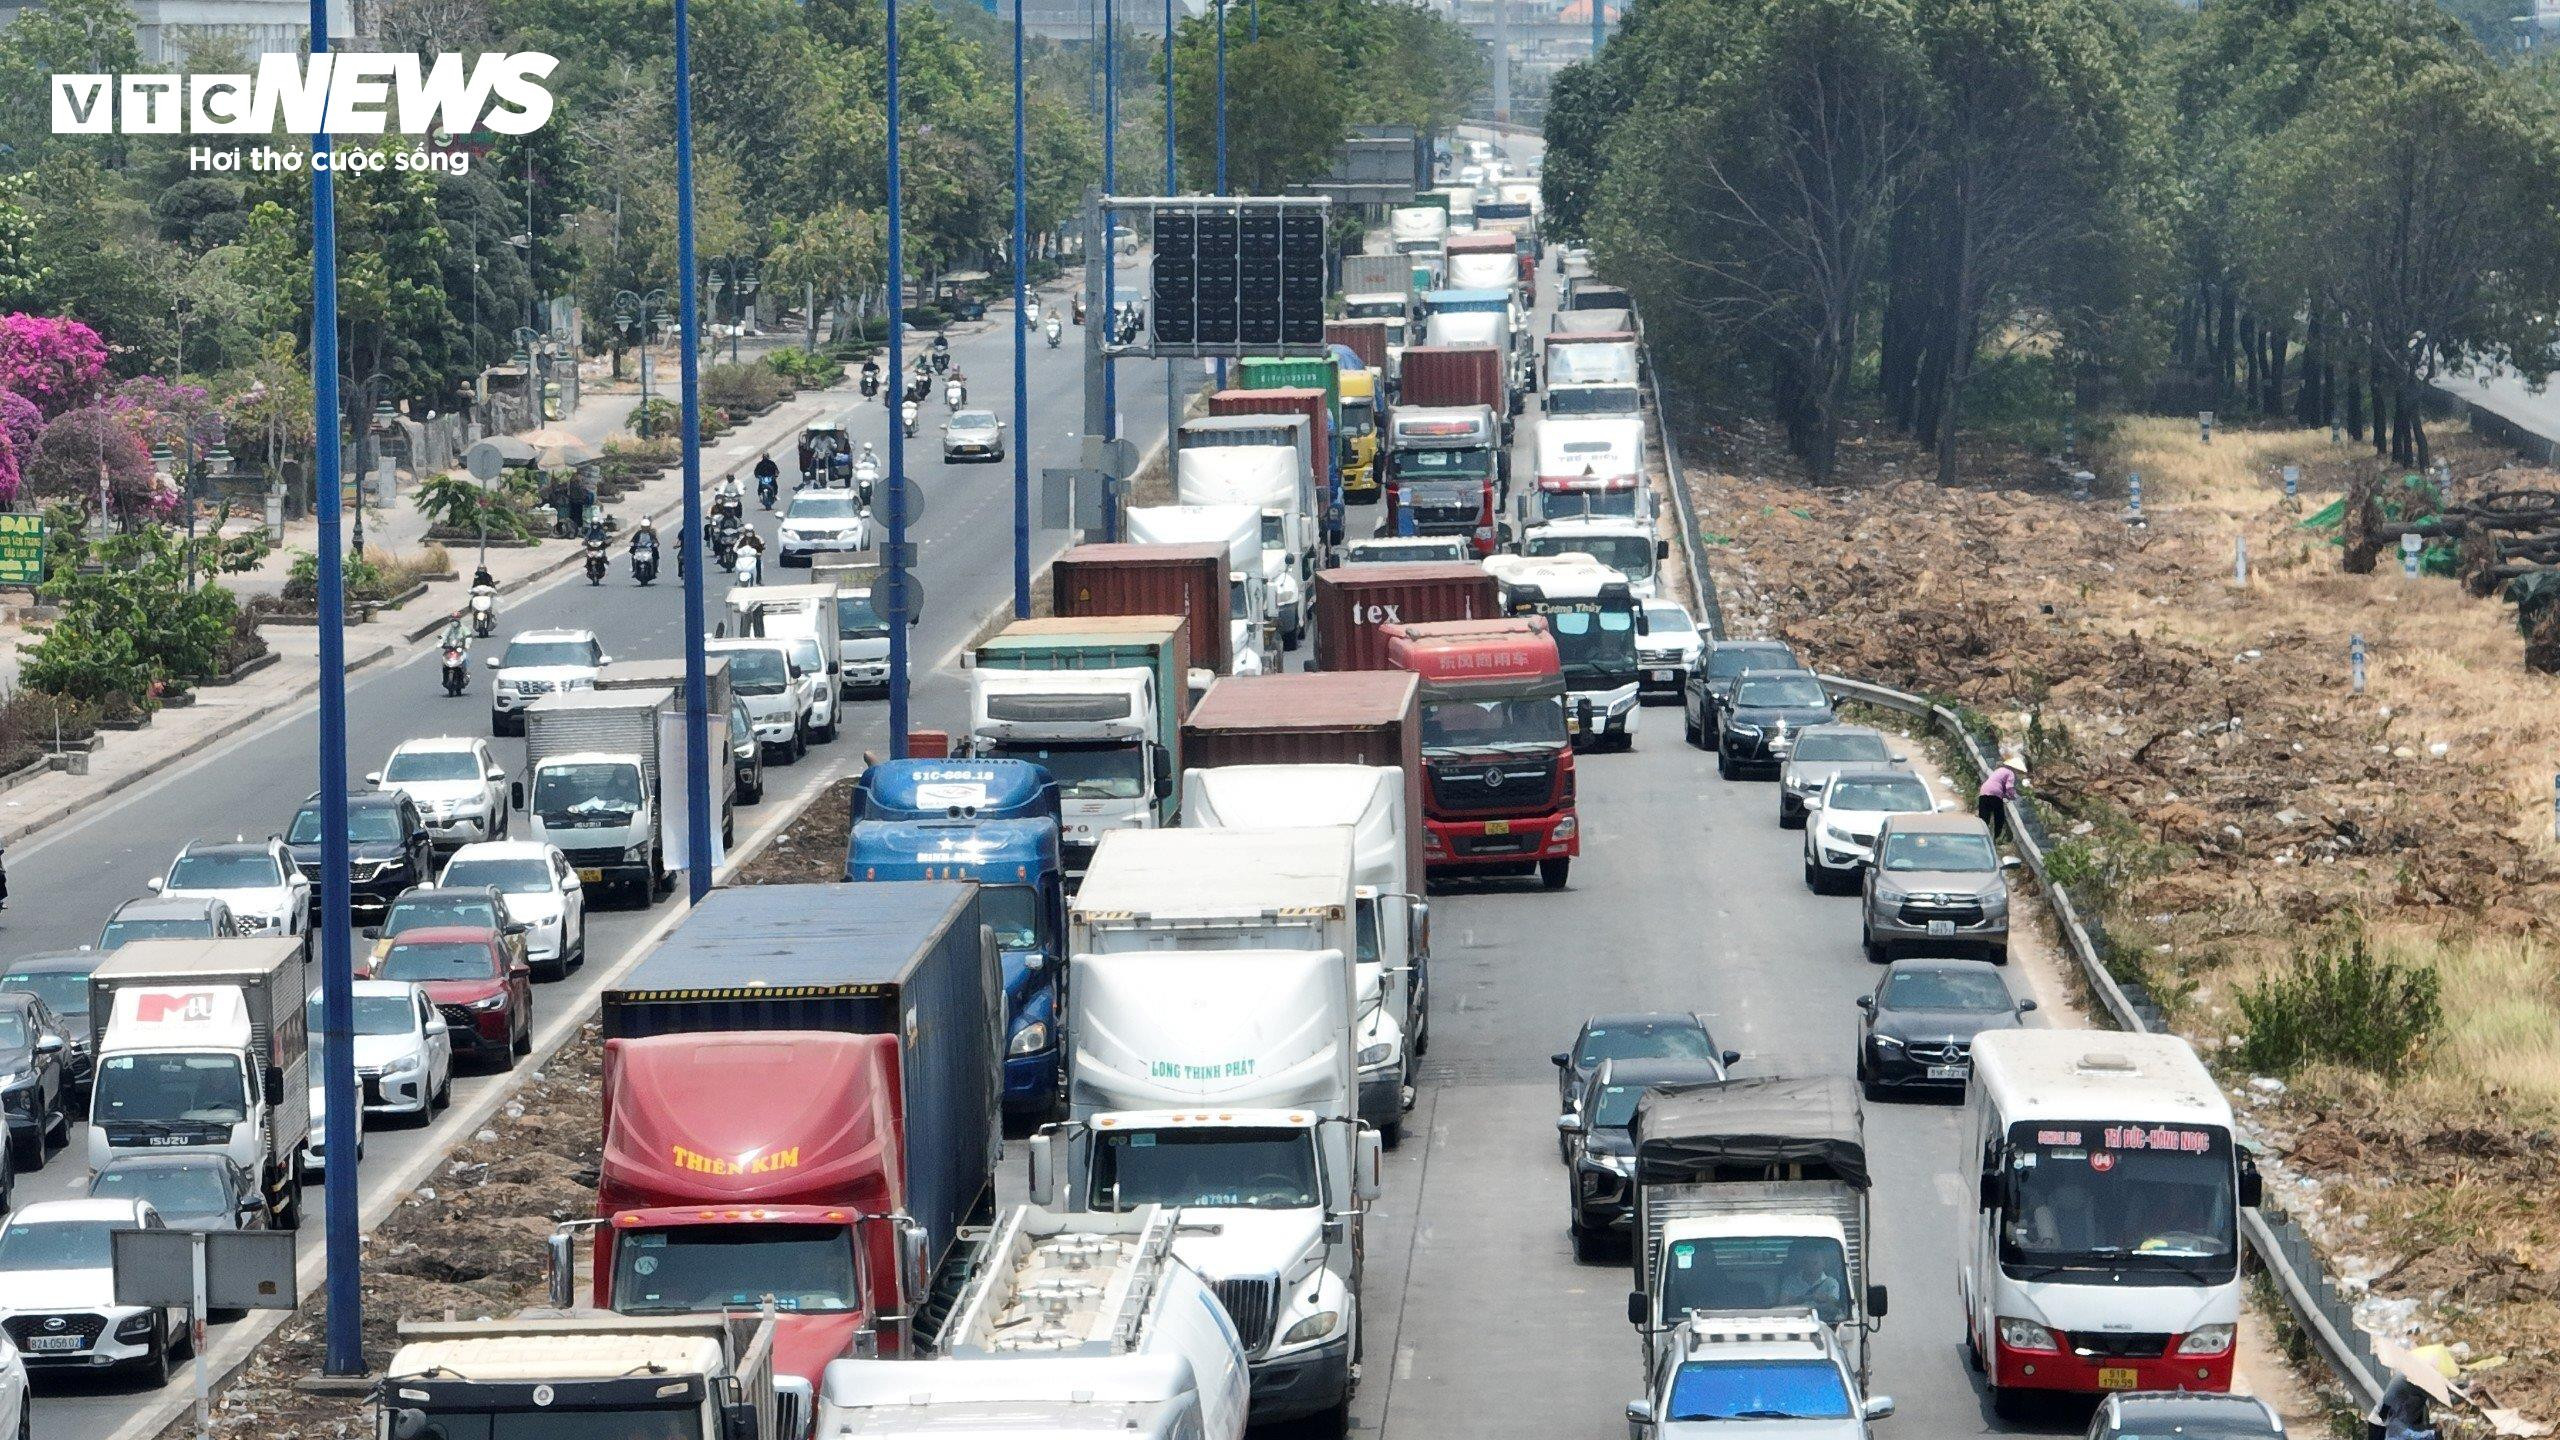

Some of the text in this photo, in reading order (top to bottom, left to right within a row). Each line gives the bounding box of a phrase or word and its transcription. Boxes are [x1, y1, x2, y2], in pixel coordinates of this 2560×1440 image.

[1353, 600, 1400, 625] tex
[1151, 1060, 1181, 1078] LONG
[150, 1137, 188, 1146] ISUZU
[673, 1145, 799, 1175] THIÊN KIM
